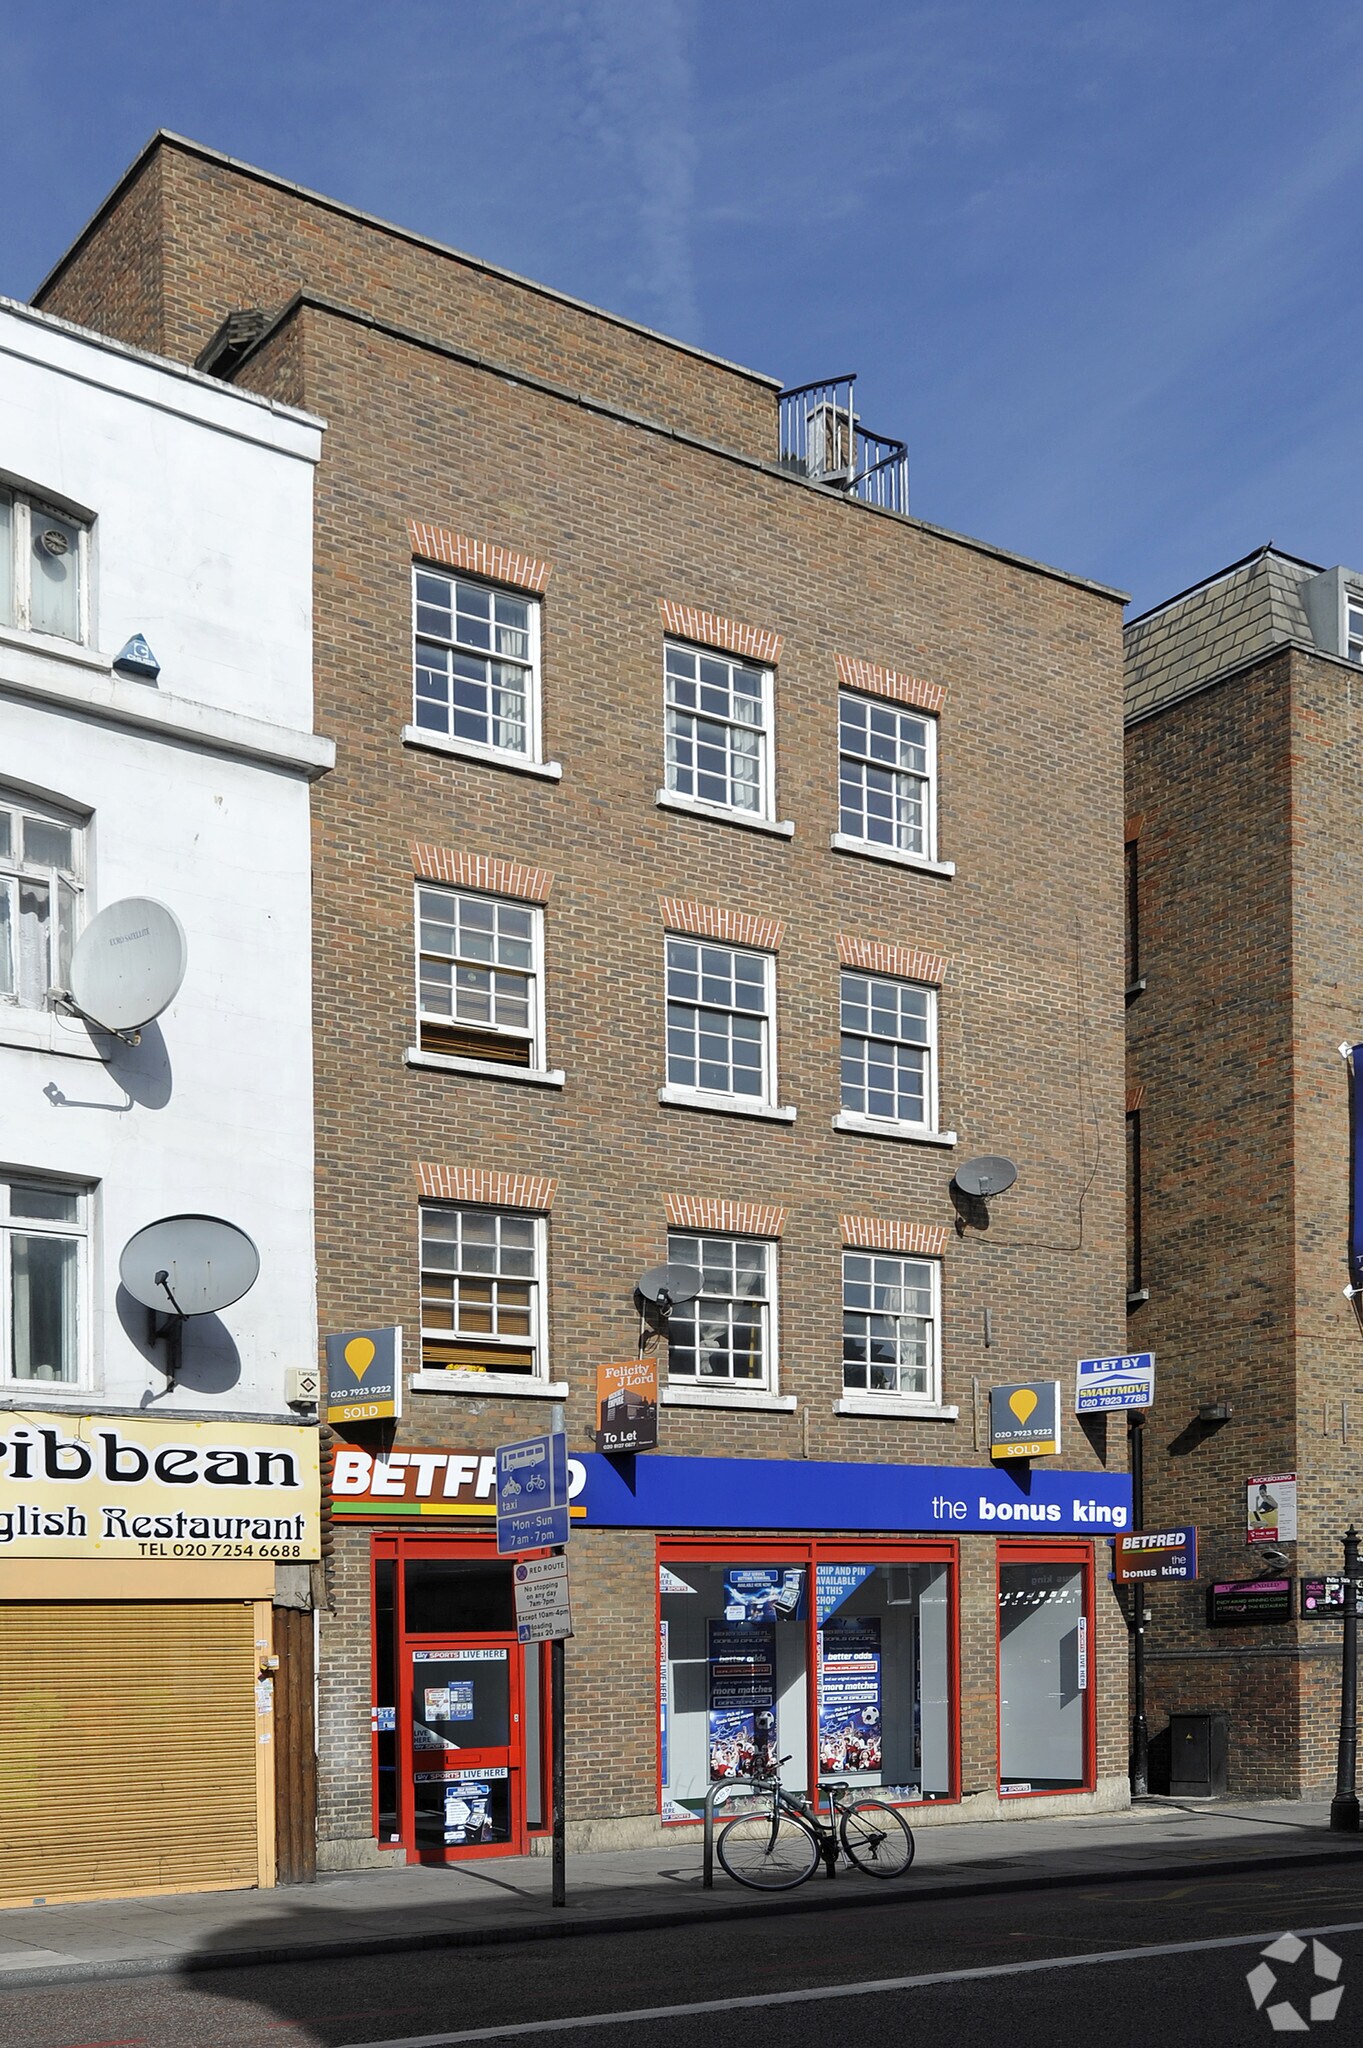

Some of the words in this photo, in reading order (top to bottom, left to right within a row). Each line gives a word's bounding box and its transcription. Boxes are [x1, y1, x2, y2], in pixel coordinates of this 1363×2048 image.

[605, 1364, 649, 1378] Felicity
[1093, 1361, 1117, 1372] LET
[1122, 1358, 1140, 1369] BY
[617, 1376, 624, 1387] J
[626, 1373, 654, 1386] Lord
[331, 1390, 347, 1398] 020
[350, 1388, 369, 1396] 7923
[371, 1385, 391, 1394] 9222
[1080, 1383, 1149, 1398] SMARTMOVE
[1081, 1398, 1097, 1407] 020
[1100, 1397, 1122, 1405] 7923
[1125, 1394, 1147, 1403] 7788
[344, 1406, 378, 1418] SOLD
[604, 1433, 617, 1443] To
[621, 1430, 637, 1442] Let
[1007, 1445, 1040, 1455] SOLD
[0, 1430, 299, 1486] ibbean
[332, 1451, 587, 1499] BETF
[502, 1500, 518, 1512] taxi
[932, 1496, 967, 1519] the
[979, 1497, 1061, 1521] bonus
[1073, 1500, 1127, 1527] king
[102, 1508, 305, 1540] Restaurant
[1122, 1533, 1186, 1550] BETFRED
[139, 1543, 168, 1556] TEL
[173, 1544, 207, 1557] 020
[211, 1544, 253, 1557] 7254
[259, 1545, 301, 1558] 6688
[1171, 1555, 1186, 1564] the
[529, 1565, 542, 1574] RED
[543, 1561, 564, 1571] ROUTE
[816, 1566, 834, 1575] CHIP
[835, 1567, 851, 1575] AND
[852, 1567, 866, 1575] PIN
[1123, 1568, 1157, 1579] bonus
[1161, 1567, 1186, 1577] king
[533, 1581, 559, 1592] stopping
[816, 1576, 856, 1585] AVAILABLE
[535, 1593, 545, 1601] any
[546, 1590, 557, 1599] day
[816, 1586, 824, 1595] IN
[826, 1586, 843, 1595] THIS
[816, 1596, 836, 1605] SHOP
[519, 1614, 537, 1622] Except
[531, 1622, 553, 1631] loading
[532, 1630, 544, 1638] max
[545, 1629, 554, 1637] 20
[555, 1627, 569, 1635] mins
[463, 1650, 480, 1658] LIVE
[483, 1650, 504, 1658] HERE
[853, 1652, 872, 1660] odds
[845, 1681, 878, 1690] matches
[464, 1770, 481, 1778] LIVE
